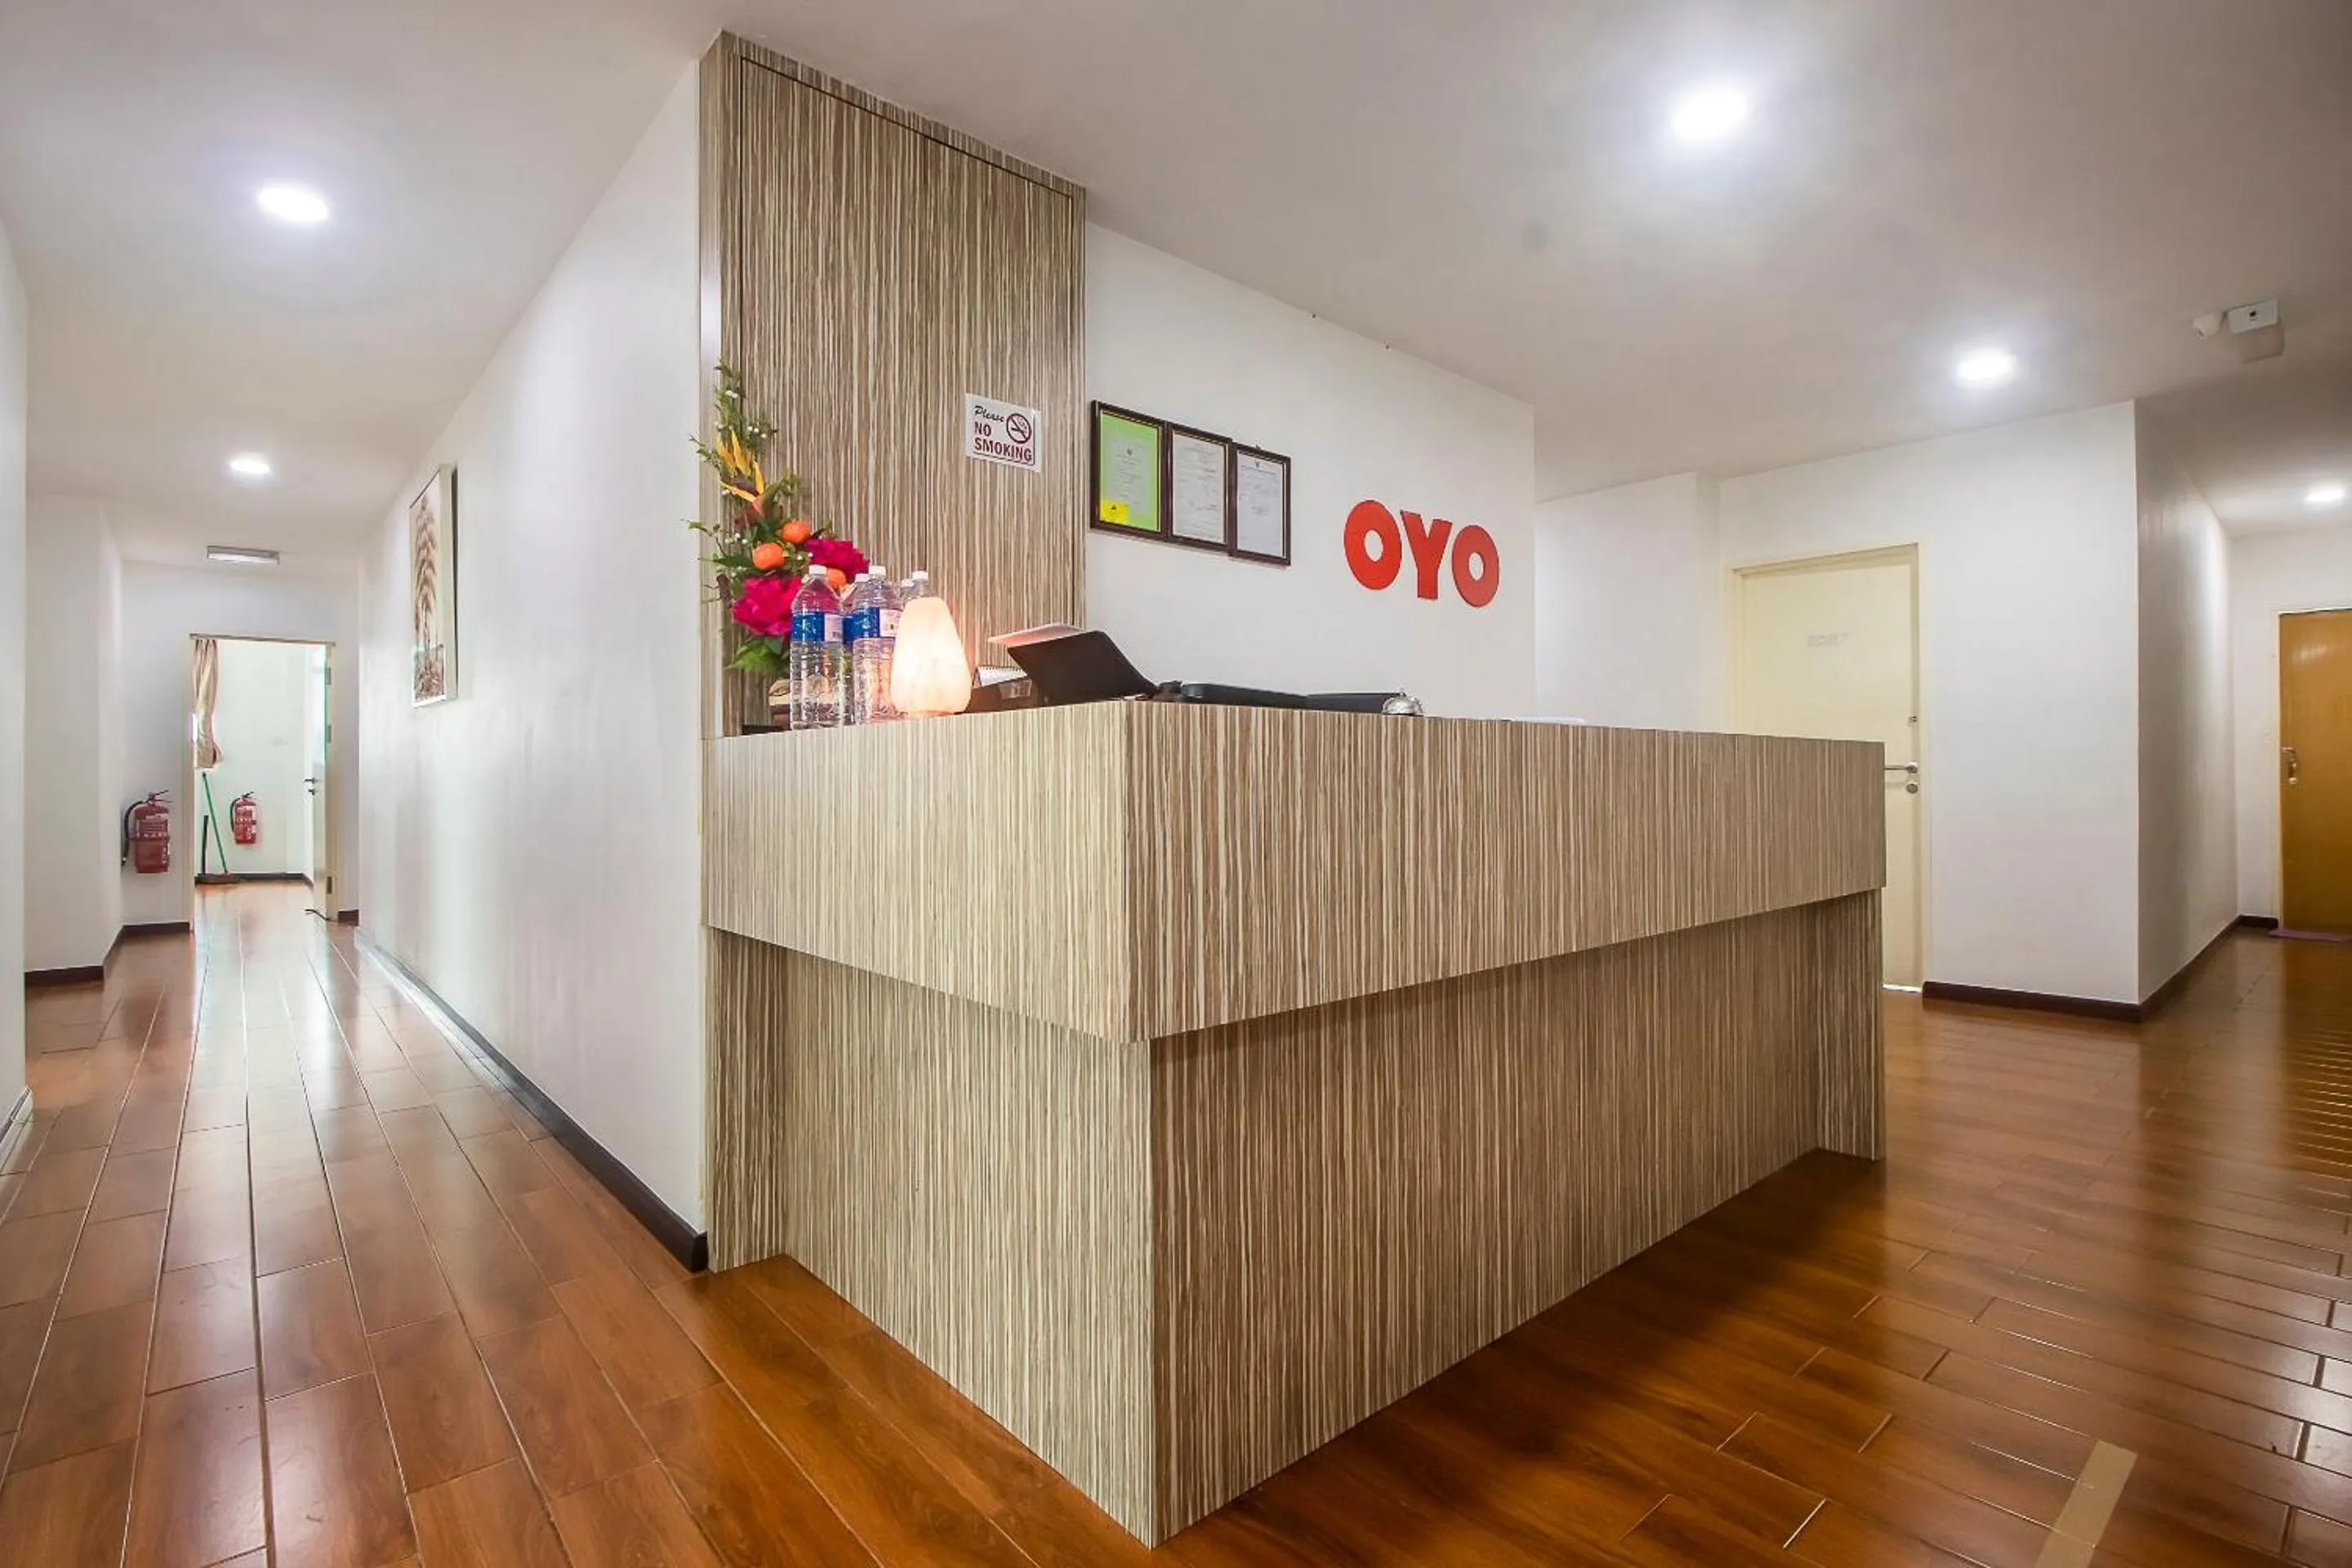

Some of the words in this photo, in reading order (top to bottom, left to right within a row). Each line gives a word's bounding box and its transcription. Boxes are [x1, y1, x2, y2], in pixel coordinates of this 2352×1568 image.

[974, 405, 1004, 422] Please
[974, 421, 991, 437] NO
[974, 437, 1032, 461] SMOKING
[1343, 499, 1499, 608] OYO
